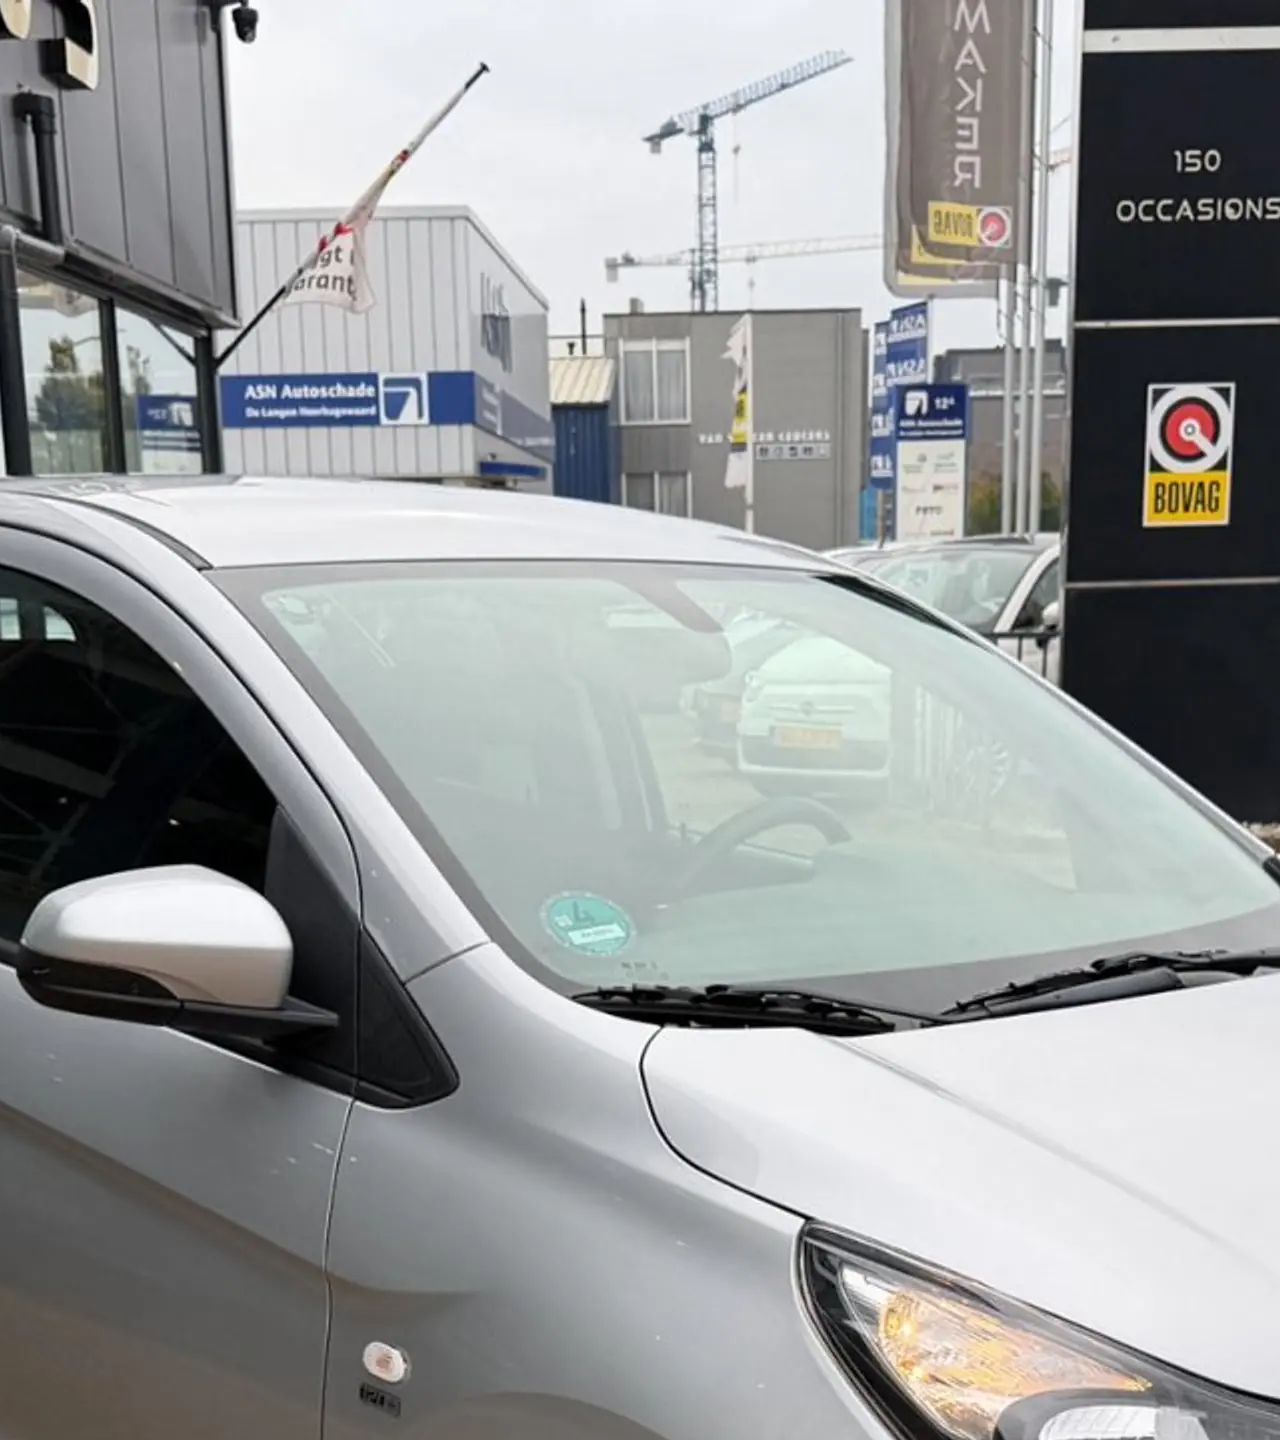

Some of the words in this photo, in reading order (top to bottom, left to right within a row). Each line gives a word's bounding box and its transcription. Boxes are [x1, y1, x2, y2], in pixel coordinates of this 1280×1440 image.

[1174, 149, 1221, 173] 150
[245, 383, 277, 399] ASN
[281, 382, 376, 399] Autoschade
[1154, 481, 1220, 514] BOVAG
